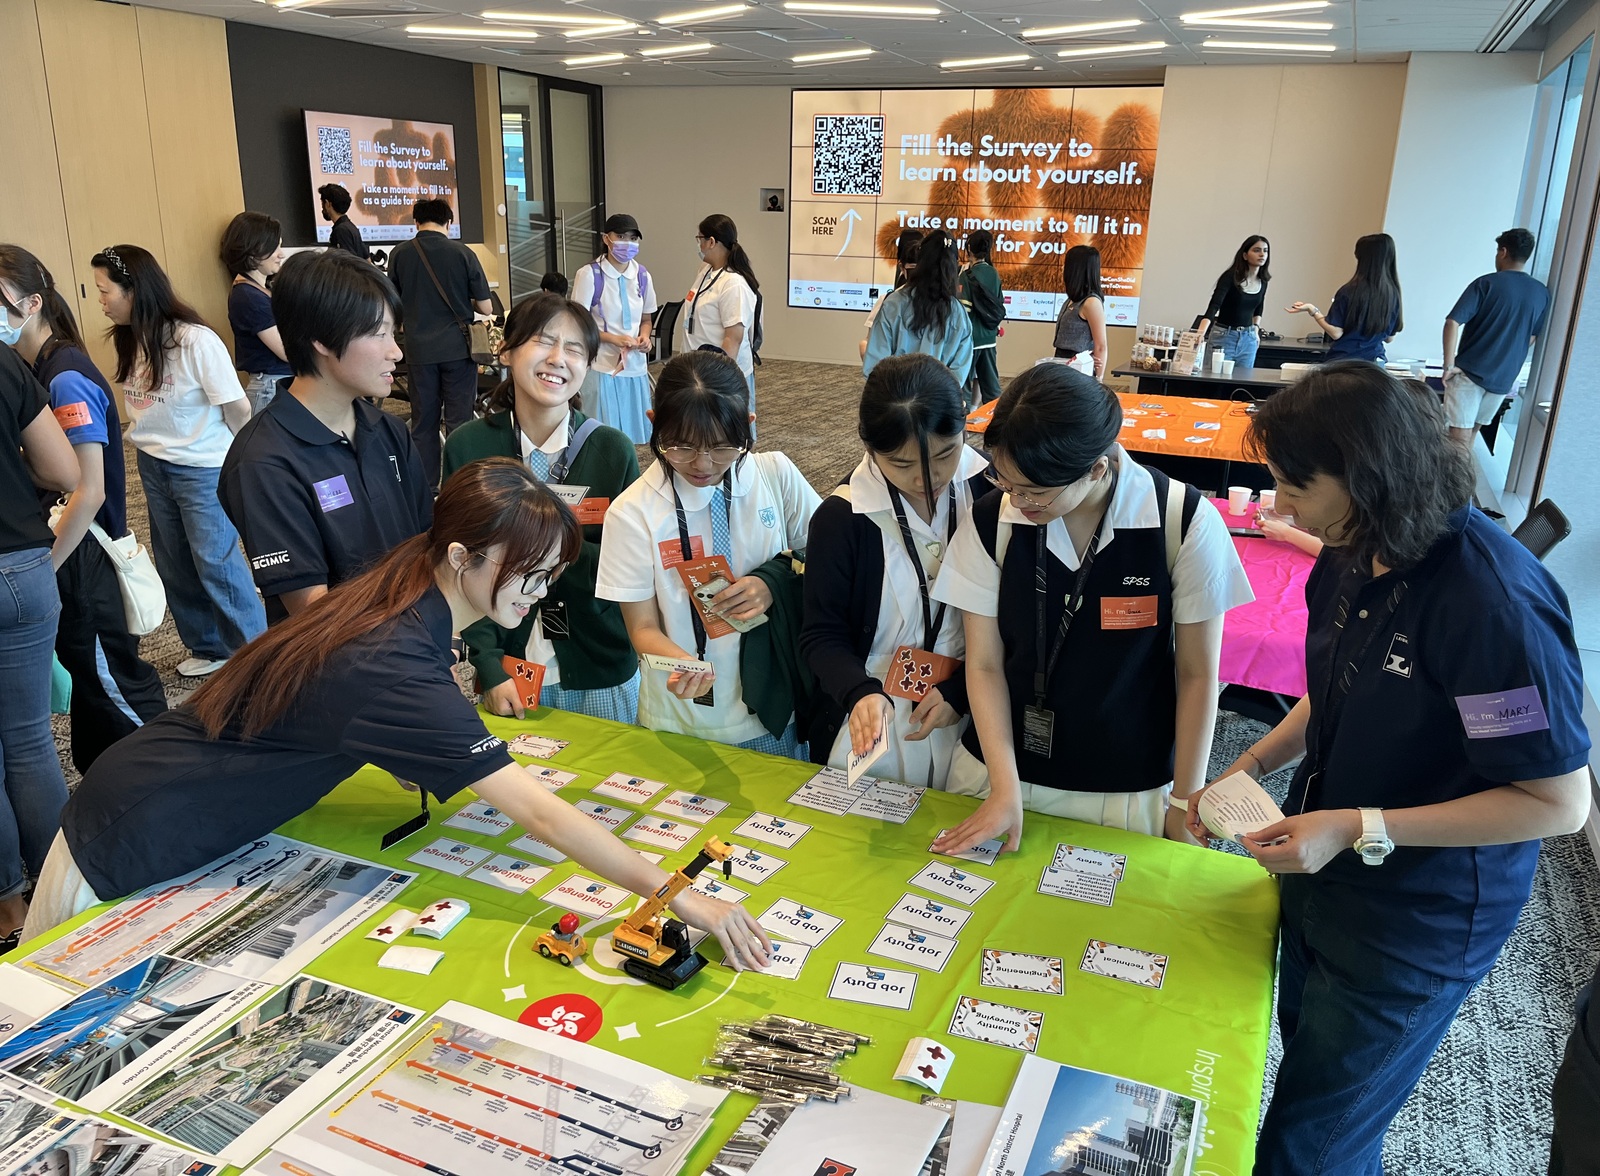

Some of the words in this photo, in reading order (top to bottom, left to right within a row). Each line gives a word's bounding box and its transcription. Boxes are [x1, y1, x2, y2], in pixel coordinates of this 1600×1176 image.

[358, 141, 372, 153] Fill
[374, 141, 389, 154] the
[390, 142, 420, 159] Survey
[421, 146, 431, 157] to
[900, 134, 931, 156] Fill
[937, 136, 974, 157] the
[979, 135, 1063, 163] Survey
[1069, 138, 1093, 158] to
[359, 154, 384, 168] learn
[386, 156, 412, 169] about
[413, 159, 449, 172] yourself.
[900, 160, 956, 182] learn
[963, 160, 1031, 183] about
[1037, 162, 1142, 189] yourself.
[362, 183, 381, 193] Take
[383, 186, 388, 194] a
[390, 185, 419, 195] moment
[420, 185, 428, 195] to
[429, 184, 438, 195] fill
[438, 185, 444, 195] it
[444, 186, 452, 195] in
[363, 196, 372, 205] as
[373, 197, 379, 205] a
[380, 195, 402, 208] guide
[403, 195, 414, 205] for
[812, 217, 837, 226] SCAN
[897, 210, 941, 229] Take
[946, 217, 958, 229] a
[964, 216, 1043, 232] moment
[1048, 217, 1069, 233] to
[1074, 215, 1099, 235] fill
[1104, 216, 1118, 235] it
[1123, 216, 1142, 236] in
[812, 226, 834, 236] HERE
[996, 234, 1025, 252] for
[144, 392, 165, 403] TOUR
[259, 554, 290, 568] CIMIC
[1123, 576, 1151, 586] SPSS
[677, 664, 706, 672] Duty
[1465, 713, 1479, 721] Hi.
[1481, 712, 1495, 720] I'm
[1499, 704, 1531, 720] MARY
[603, 780, 653, 797] Challenge
[876, 786, 908, 795] Accounting
[664, 798, 715, 816] Challenge
[811, 800, 846, 812] Responsible
[875, 805, 909, 814] controlling
[457, 812, 510, 828] Challenge
[883, 810, 907, 819] Project
[634, 824, 688, 842] Challenge
[750, 822, 774, 833] Duty
[776, 829, 796, 839] Job
[423, 847, 475, 867] Challenge
[729, 855, 747, 867] Dut
[1076, 857, 1102, 866] Safety
[482, 864, 536, 885] Challenge
[748, 863, 769, 873] Job
[927, 872, 955, 887] Duty
[1076, 874, 1113, 884] regulations
[1078, 878, 1112, 887] complying
[957, 883, 977, 894] Job
[1076, 881, 1111, 891] operations
[1079, 886, 1102, 894] ensure
[558, 886, 613, 909] Challenge
[1074, 890, 1109, 899] inspection
[1079, 894, 1109, 904] Conduct
[772, 911, 800, 926] Duty
[902, 905, 932, 919] Duty
[935, 915, 958, 926] Job
[804, 923, 824, 934] Job
[884, 936, 915, 950] Duty
[621, 943, 647, 957] LEIGHTON
[918, 946, 941, 958] Job
[773, 953, 796, 964] Job
[1103, 956, 1145, 970] Technical
[995, 966, 1048, 978] Engineering
[843, 977, 876, 990] Duty
[880, 984, 906, 994] Job
[188, 1012, 223, 1037] underneath
[975, 1012, 1021, 1028] Surveying
[379, 1023, 399, 1040] Central
[976, 1021, 1017, 1035] Quantity
[171, 1036, 191, 1049] Island
[148, 1046, 174, 1067] Eastern
[336, 1058, 359, 1074] Bypass
[121, 1065, 149, 1086] Corridor
[926, 1100, 946, 1108] CIMIC
[997, 1151, 1008, 1171] North
[1003, 1134, 1016, 1155] District
[1011, 1112, 1023, 1134] Hospital
